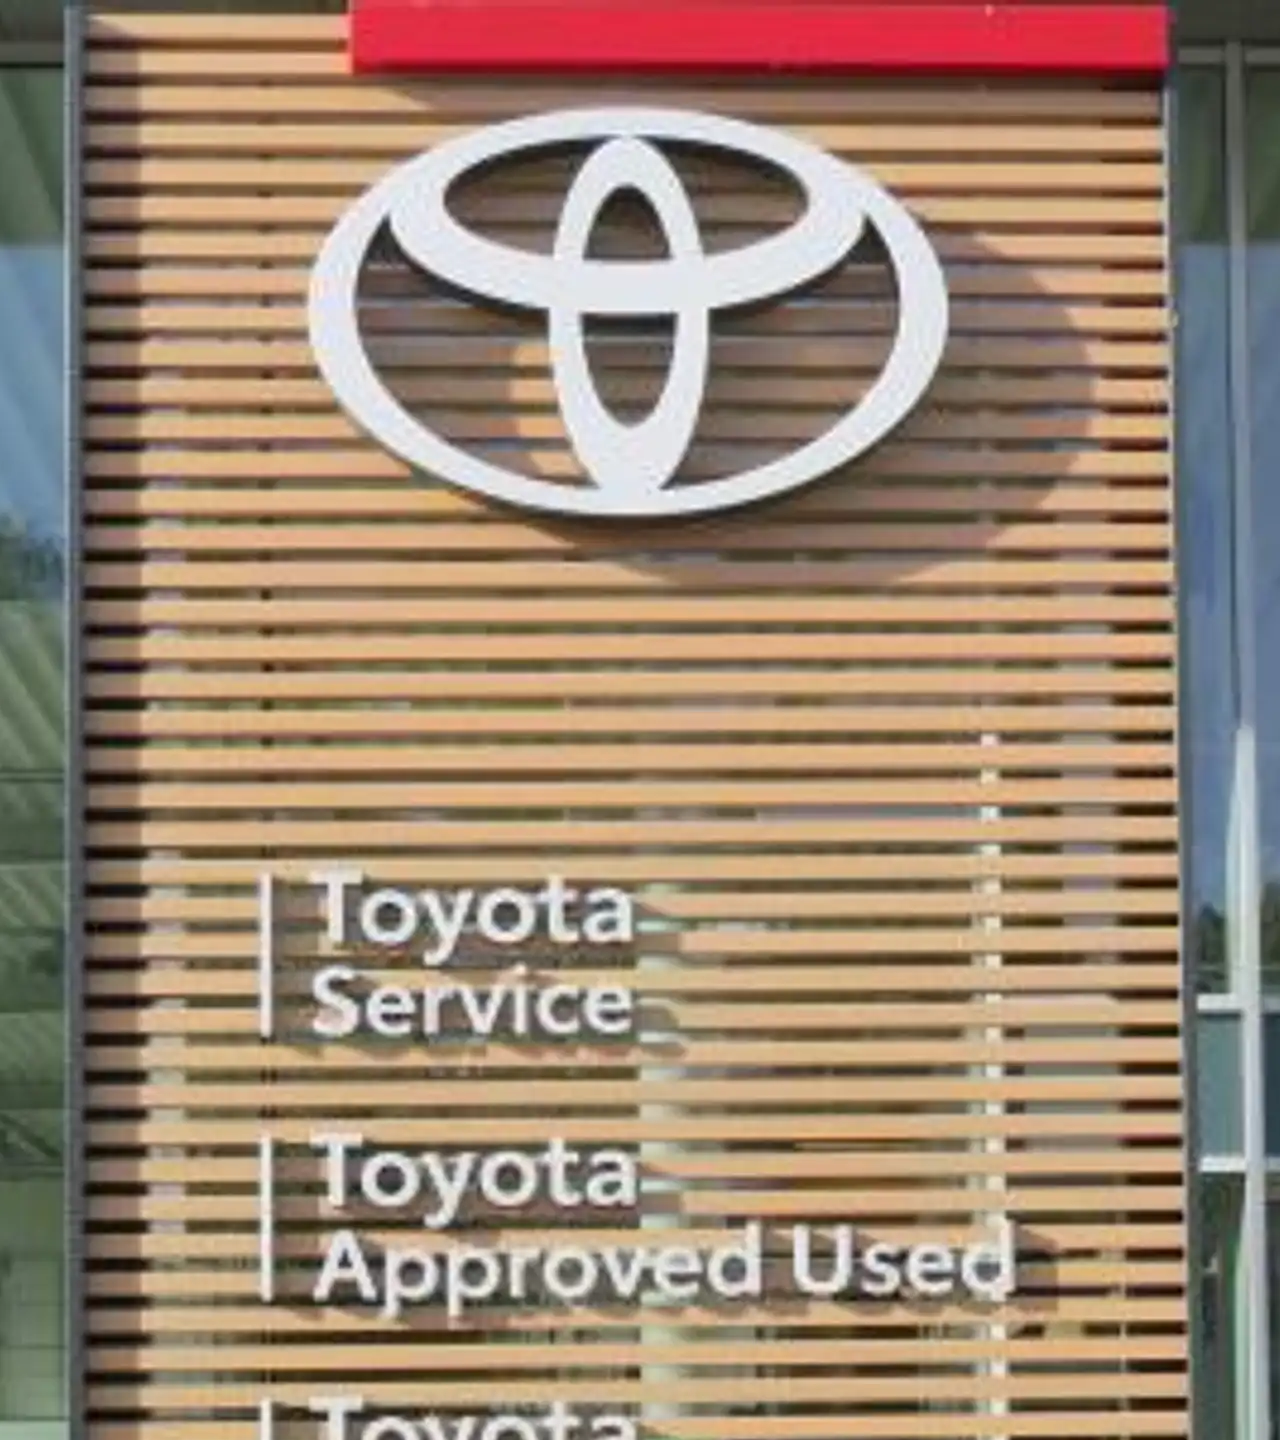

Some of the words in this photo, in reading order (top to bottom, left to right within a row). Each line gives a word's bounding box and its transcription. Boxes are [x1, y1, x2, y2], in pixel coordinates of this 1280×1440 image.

[308, 868, 636, 966] Toyota
[310, 964, 634, 1037] Service
[308, 1132, 638, 1228] Toyota
[312, 1220, 763, 1318] Approved
[792, 1215, 1016, 1300] Used
